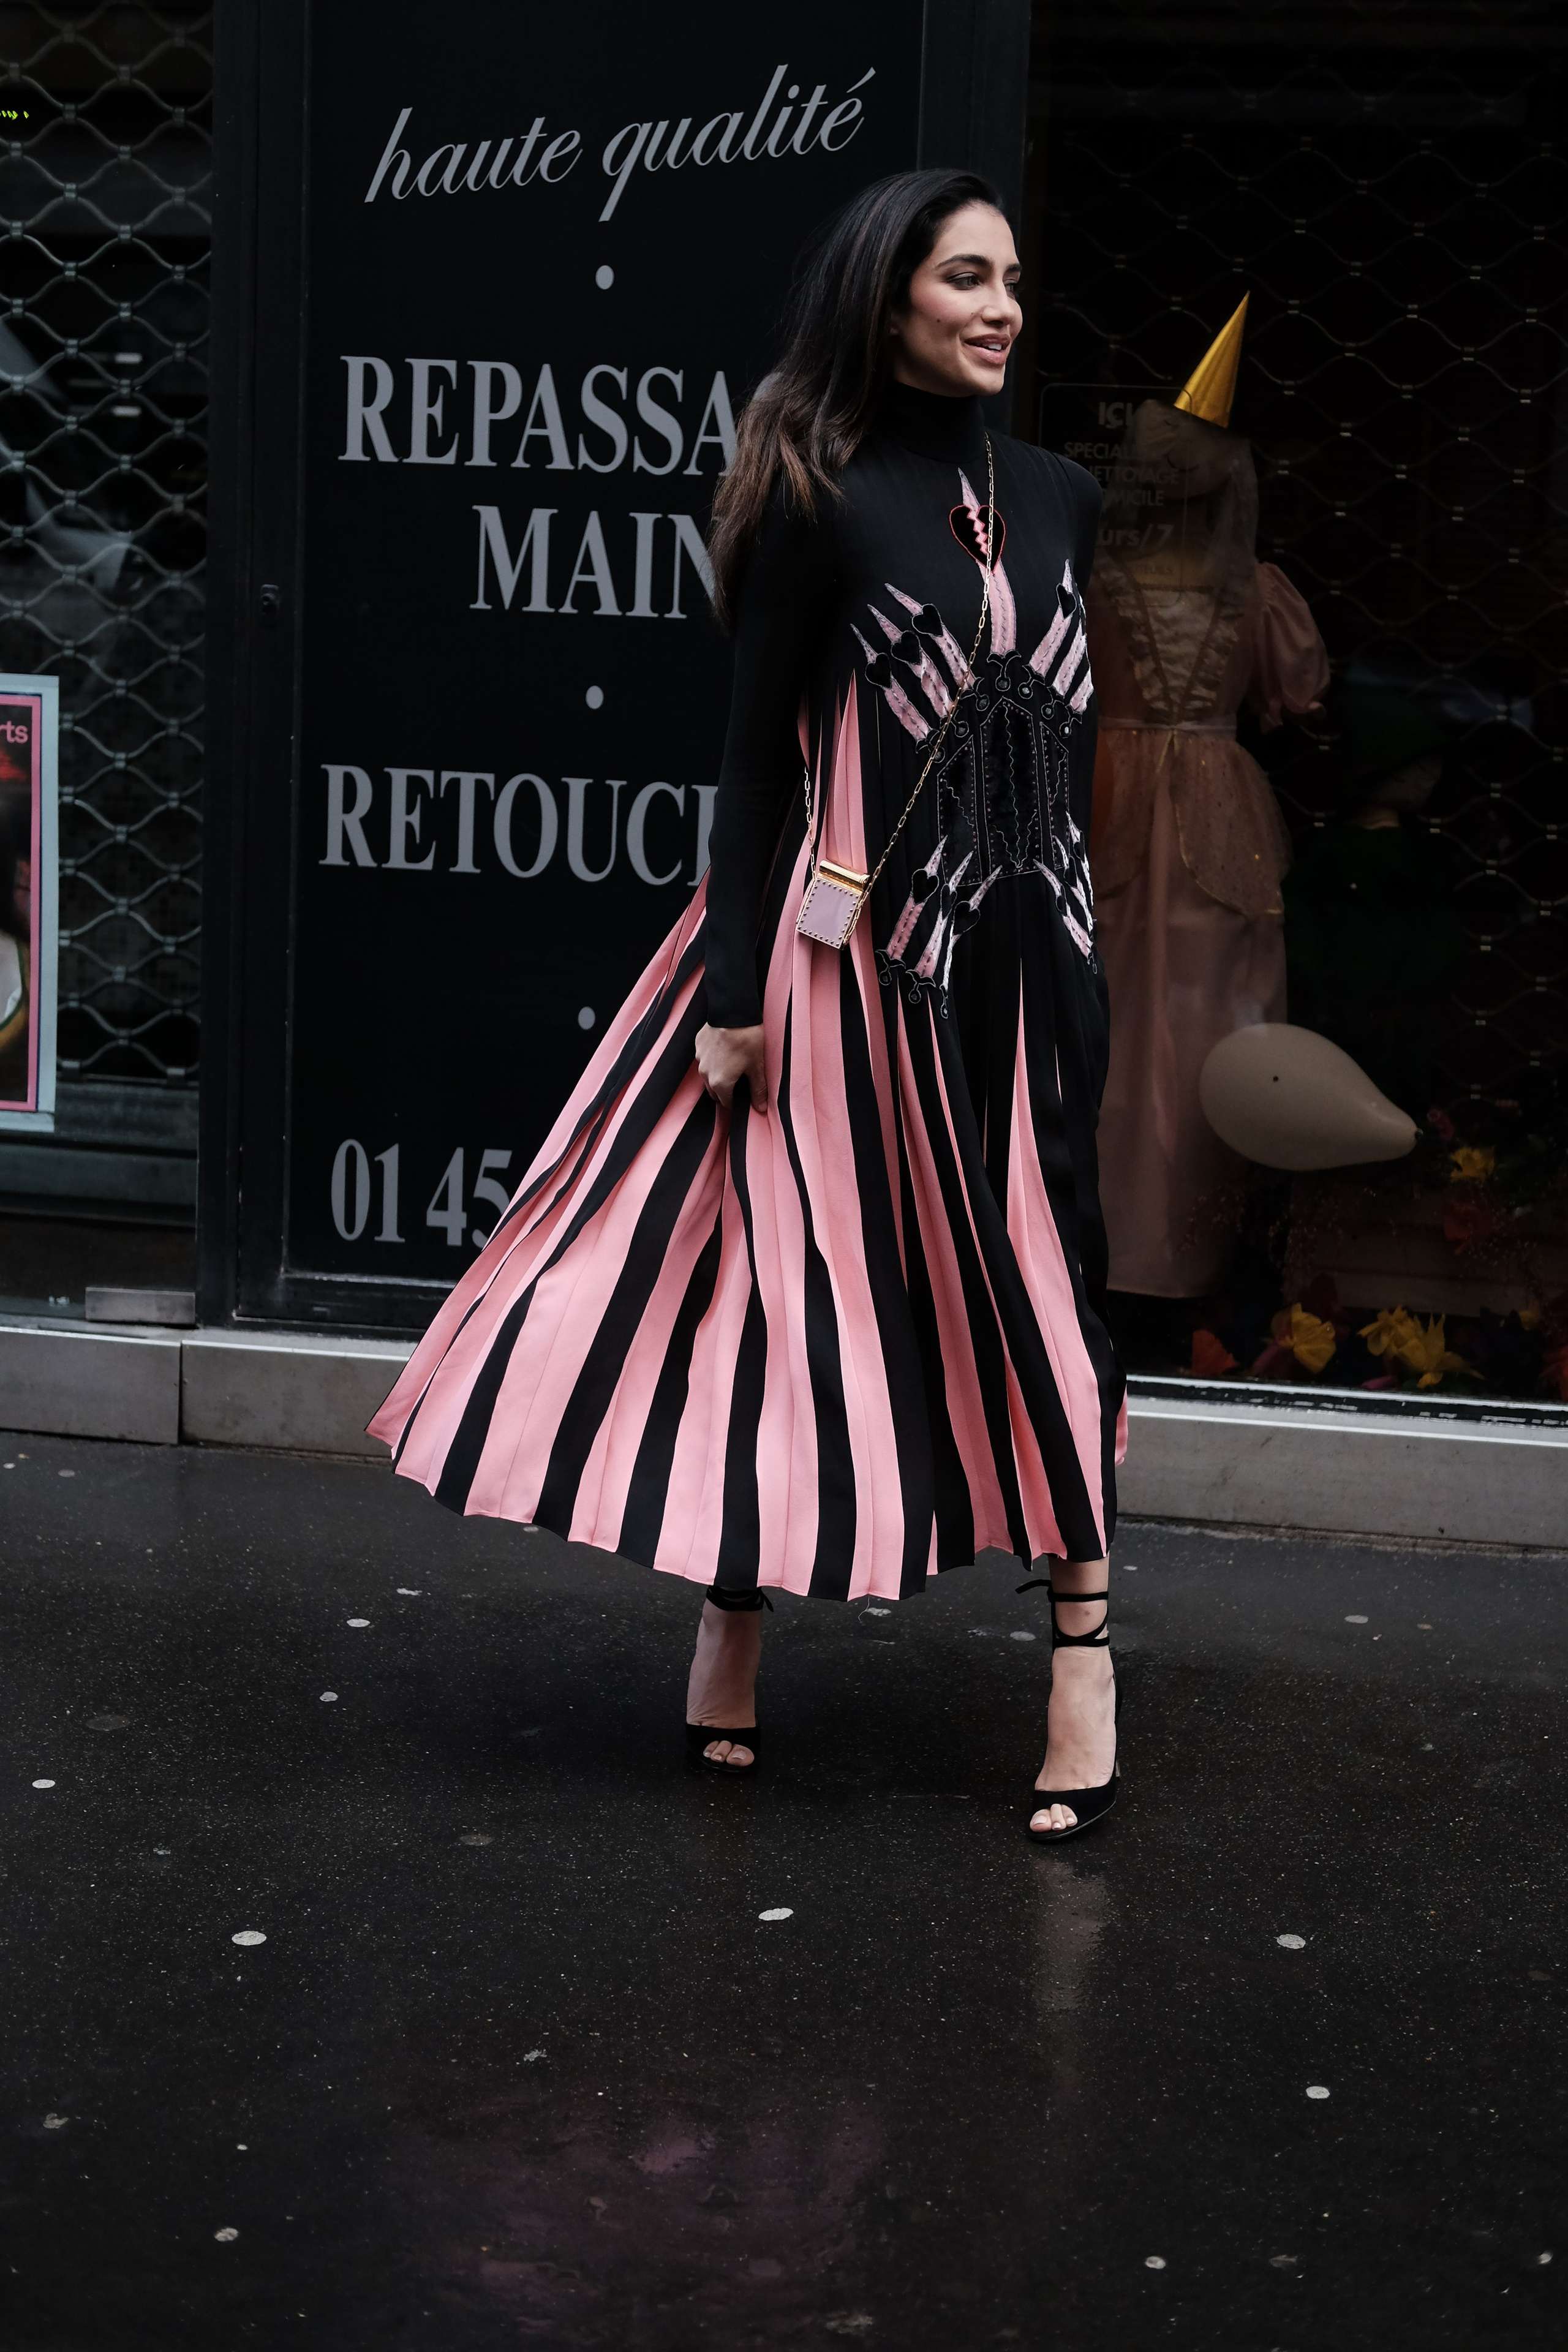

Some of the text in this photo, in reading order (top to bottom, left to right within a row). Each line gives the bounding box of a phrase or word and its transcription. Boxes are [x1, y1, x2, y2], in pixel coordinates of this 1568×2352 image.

[364, 63, 876, 222] haute qualité
[337, 355, 737, 478] REPASSA
[1063, 442, 1136, 459] SPECIAL
[1098, 401, 1133, 428] ICI
[469, 505, 720, 619] MAIN
[331, 1137, 513, 1250] 01 45
